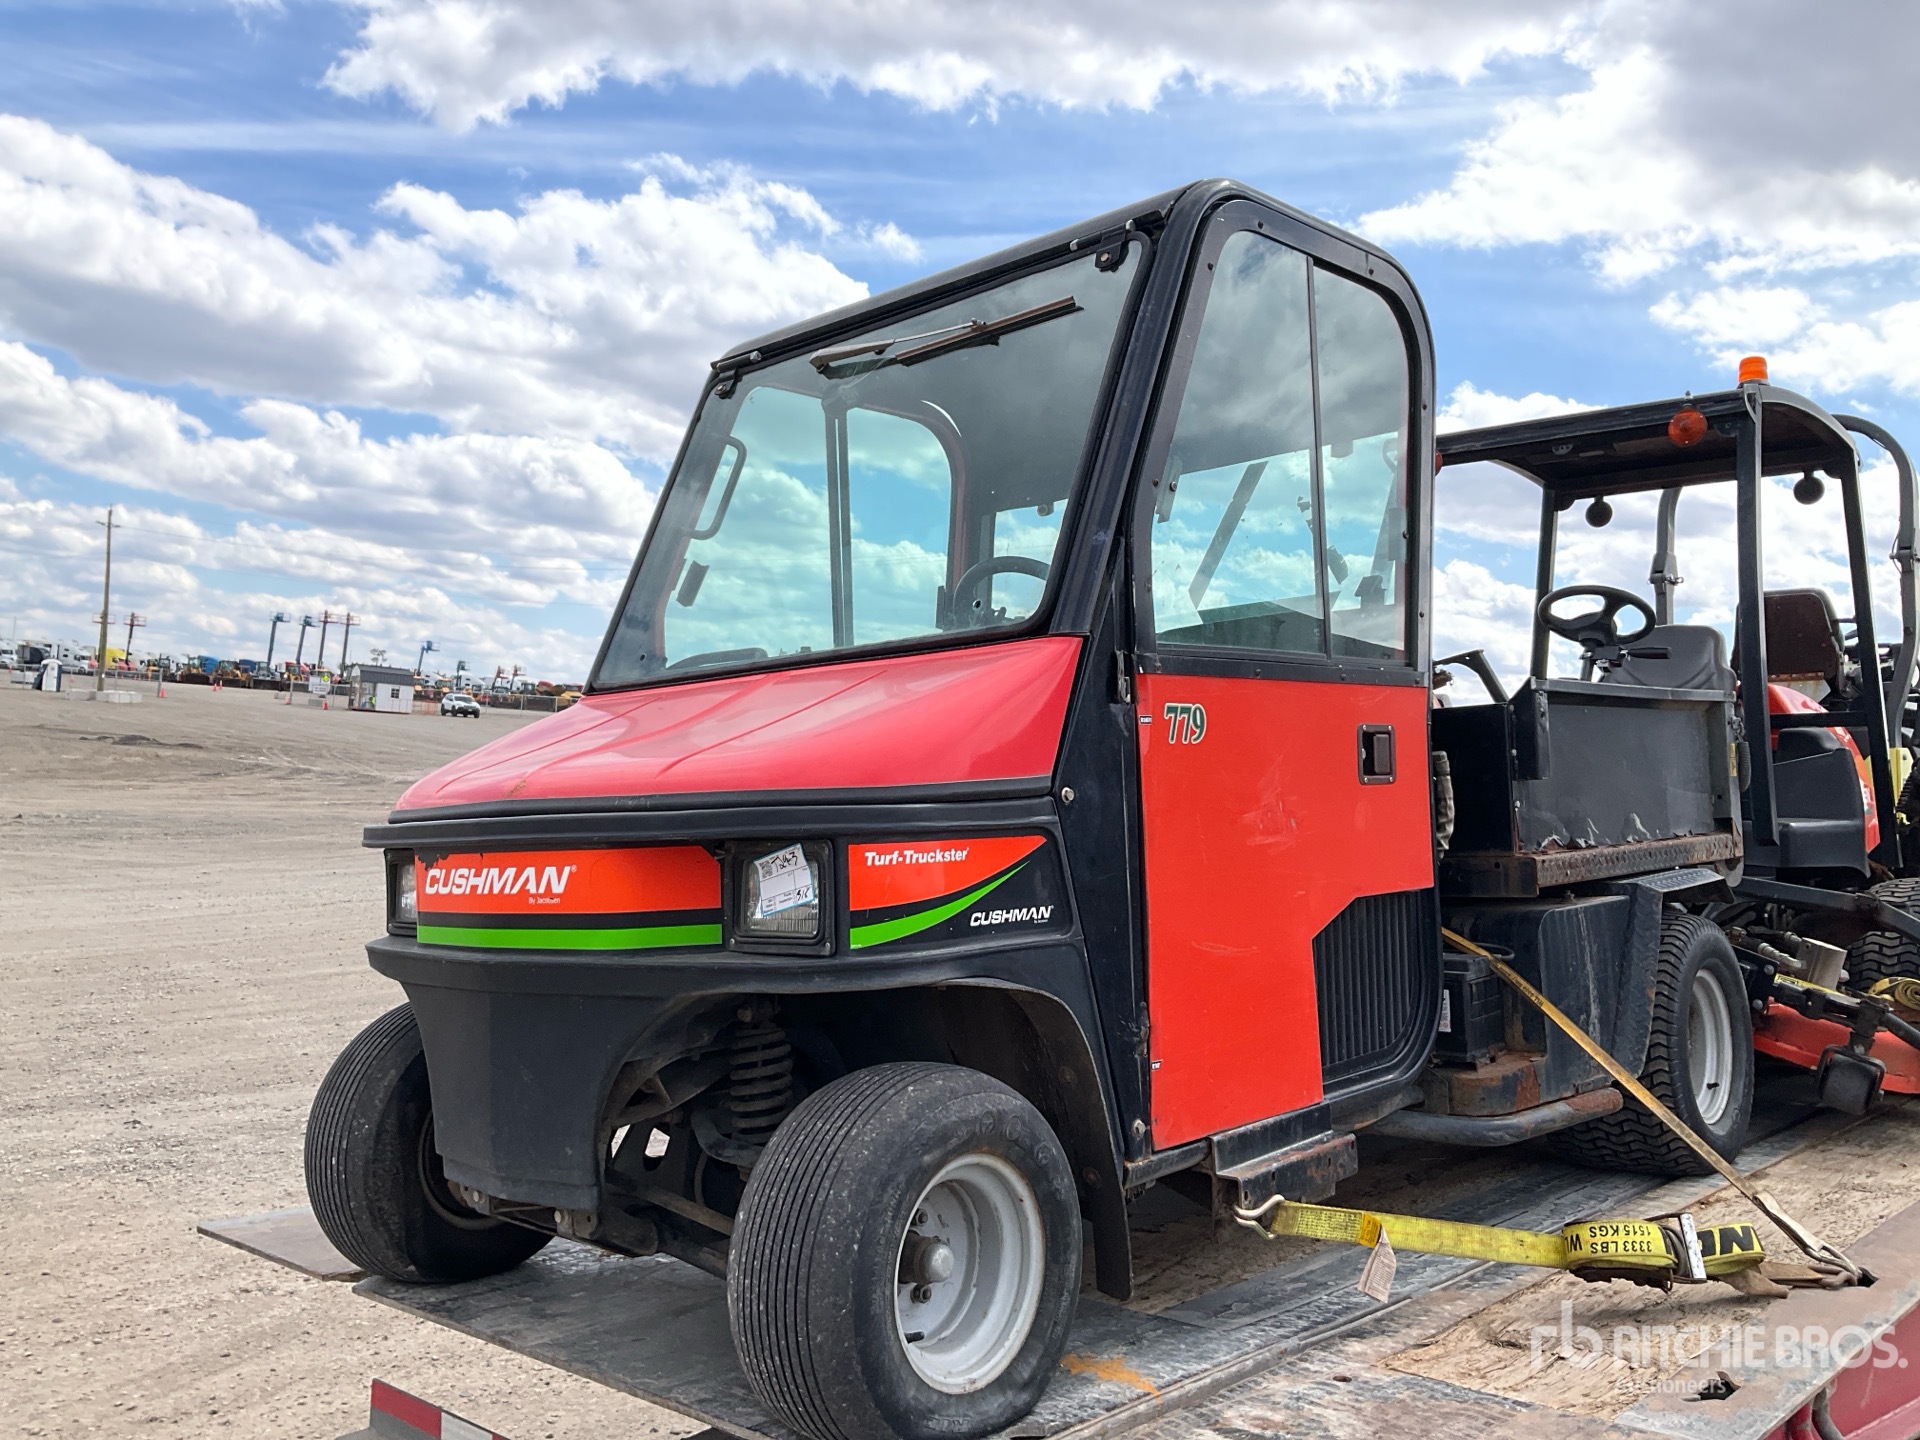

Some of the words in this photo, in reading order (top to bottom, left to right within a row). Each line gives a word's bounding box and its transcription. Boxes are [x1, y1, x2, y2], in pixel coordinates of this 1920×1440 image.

[1164, 703, 1207, 744] 779
[865, 848, 968, 866] Turf-Truckster
[425, 866, 571, 895] CUSHMAN
[970, 906, 1051, 927] CUSHMAN
[1589, 1225, 1619, 1238] KGS
[1624, 1224, 1652, 1237] 1515
[1590, 1240, 1620, 1254] LBS
[1622, 1239, 1653, 1253] 3333
